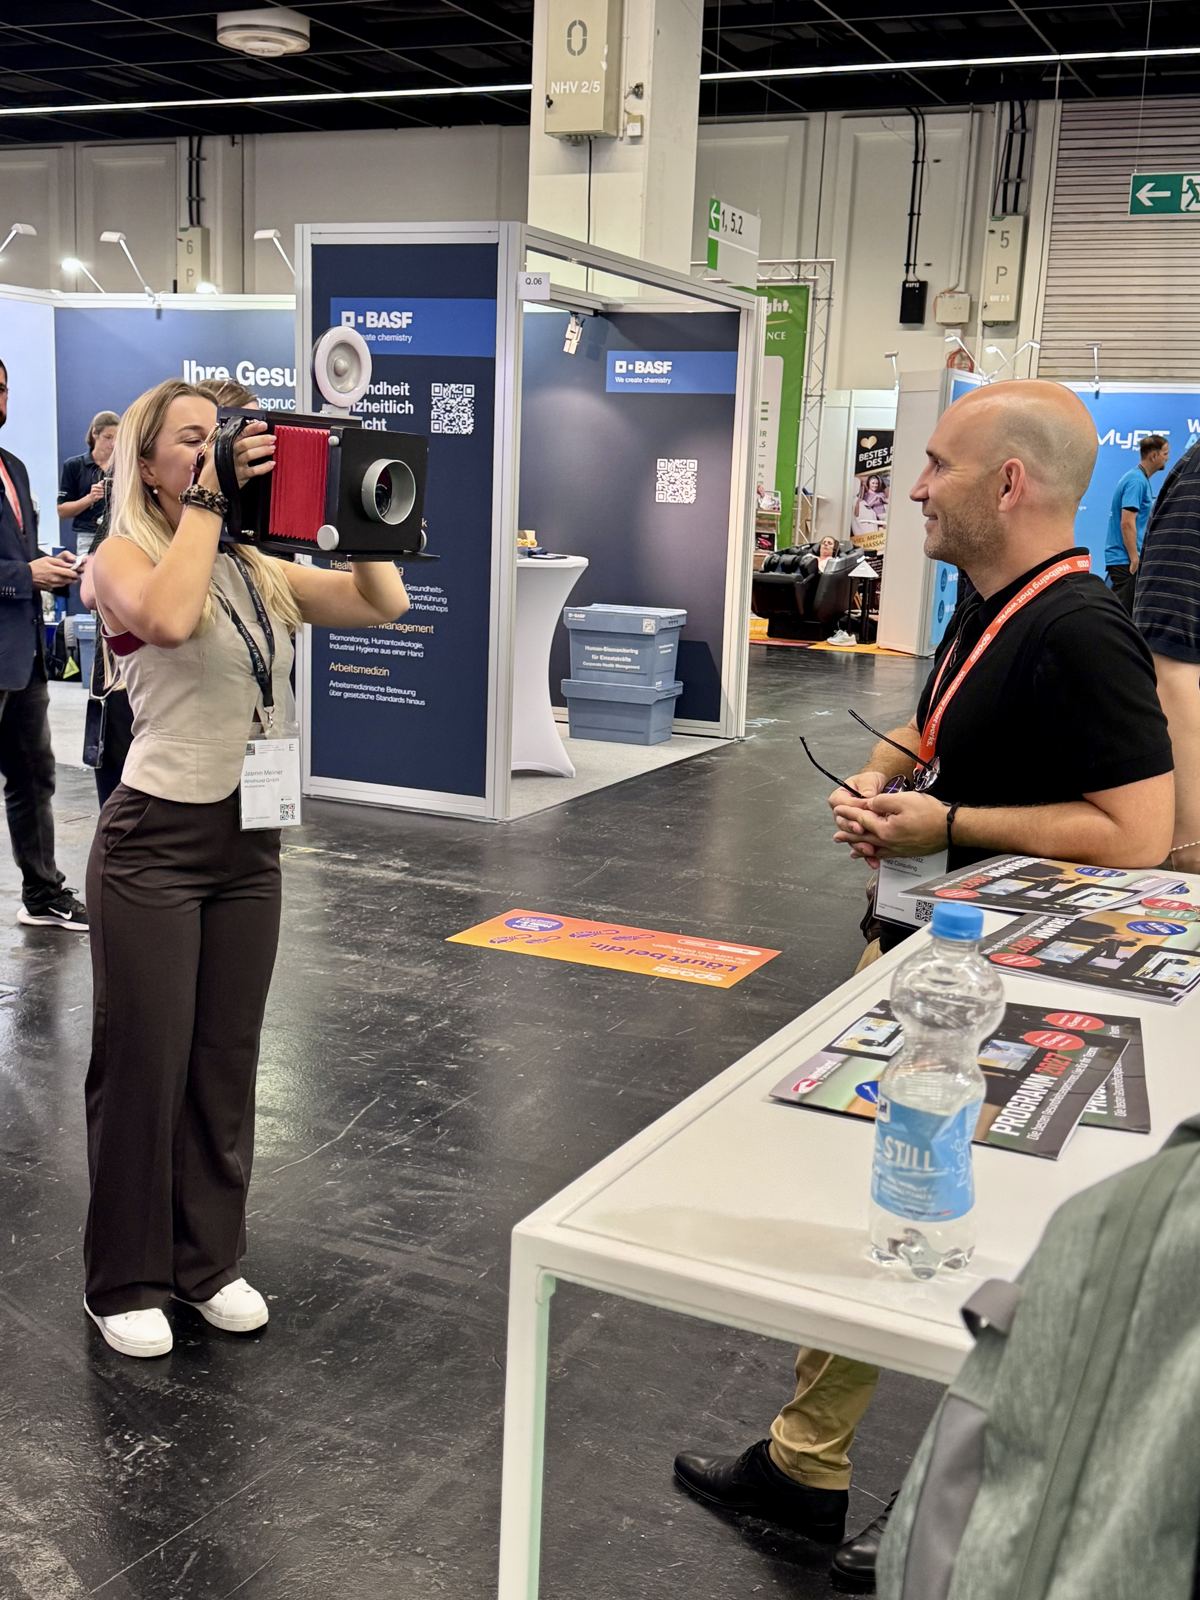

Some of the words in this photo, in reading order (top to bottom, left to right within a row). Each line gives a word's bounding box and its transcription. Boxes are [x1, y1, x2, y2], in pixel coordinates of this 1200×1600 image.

[550, 81, 578, 93] NHV
[581, 80, 601, 93] 2/5
[730, 215, 744, 235] 5.2
[186, 240, 194, 254] 6
[1000, 230, 1010, 249] 5
[186, 268, 194, 284] P
[525, 277, 543, 286] Q.06
[996, 266, 1008, 284] P
[366, 311, 413, 329] BASF
[377, 333, 413, 343] chemistry
[183, 360, 229, 385] Ihre
[634, 360, 673, 374] BASF
[366, 381, 410, 396] ndheit
[643, 377, 672, 385] chemistry
[349, 399, 414, 414] nzheitlich
[858, 447, 888, 462] BESTES
[866, 457, 882, 468] DES
[866, 532, 884, 541] MEHR
[1032, 563, 1072, 589] Wellbeing
[1016, 588, 1035, 603] that
[414, 603, 449, 613] Workshops
[329, 642, 355, 651] Industrial
[356, 646, 379, 654] Hygiene
[407, 650, 424, 658] Hand
[329, 661, 390, 676] Arbeitsmedizin
[329, 680, 385, 692] Arbeitsmedizinische
[386, 686, 416, 697] Betreuung
[329, 689, 342, 697] über
[375, 694, 405, 704] Standards
[406, 697, 425, 706] hinaus
[590, 941, 626, 952] dir.
[624, 948, 667, 960] bei
[668, 954, 739, 972] Läuft
[989, 1073, 1059, 1137] PROGRAMM
[1034, 1052, 1073, 1076] 2027
[883, 1135, 936, 1172] STILL
